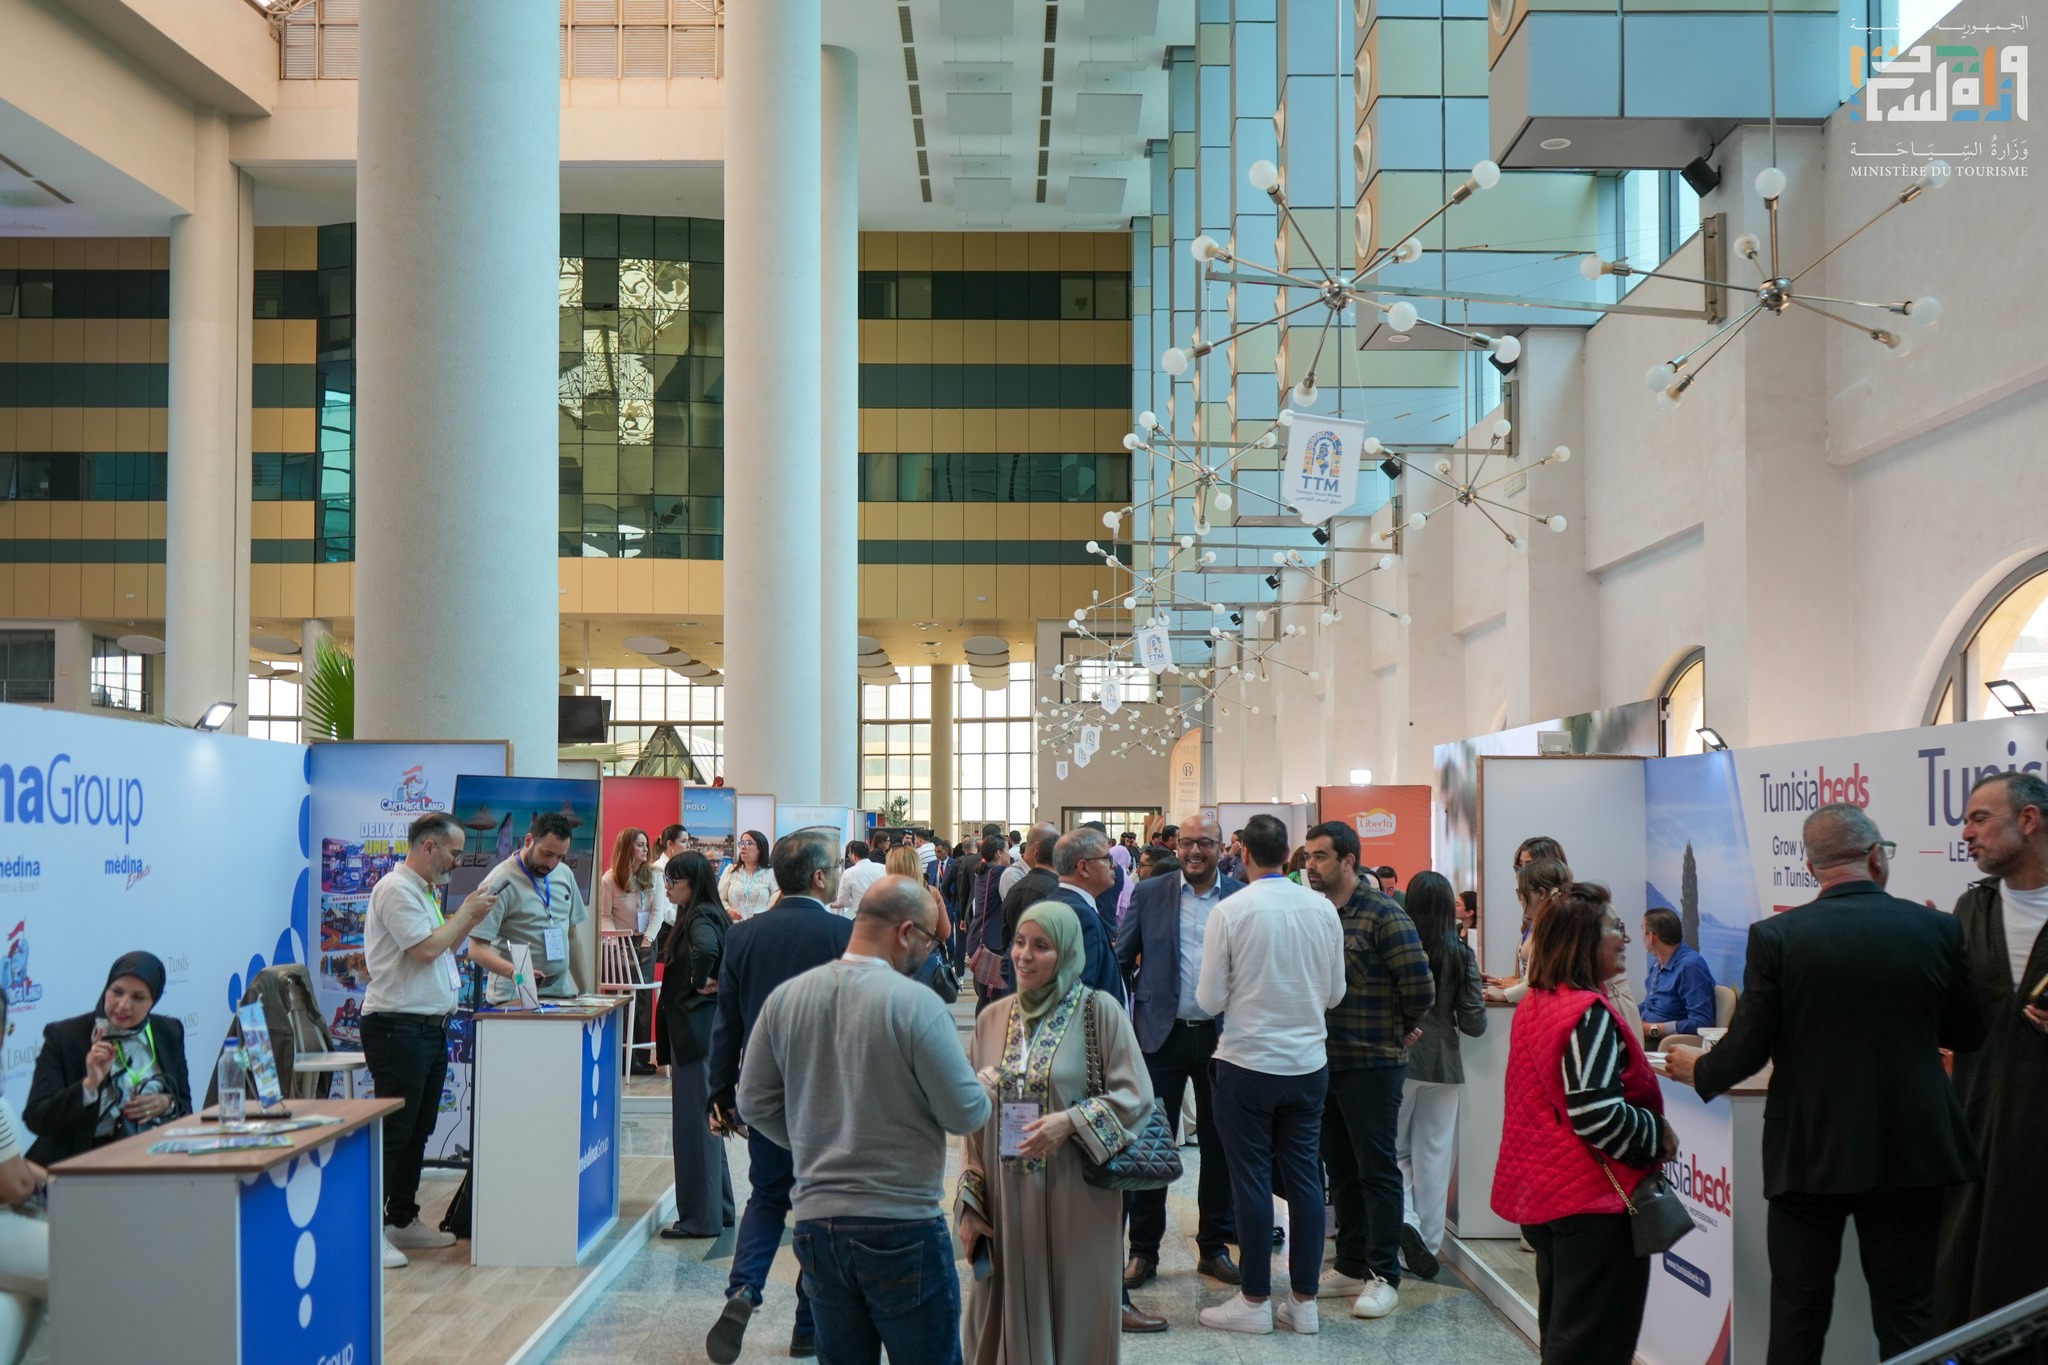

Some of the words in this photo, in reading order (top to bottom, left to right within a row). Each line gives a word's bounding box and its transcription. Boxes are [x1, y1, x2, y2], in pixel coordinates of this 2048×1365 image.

[1301, 475, 1339, 492] TTM
[1148, 653, 1165, 661] TTM
[1760, 762, 1870, 813] Tunisiabeds
[381, 799, 422, 812] CARTHAGE
[421, 799, 445, 812] LAND
[360, 823, 393, 838] DEUX
[1360, 819, 1392, 828] Liberta
[365, 840, 389, 854] UNE
[1772, 836, 1797, 856] Grow
[1773, 867, 1782, 886] in
